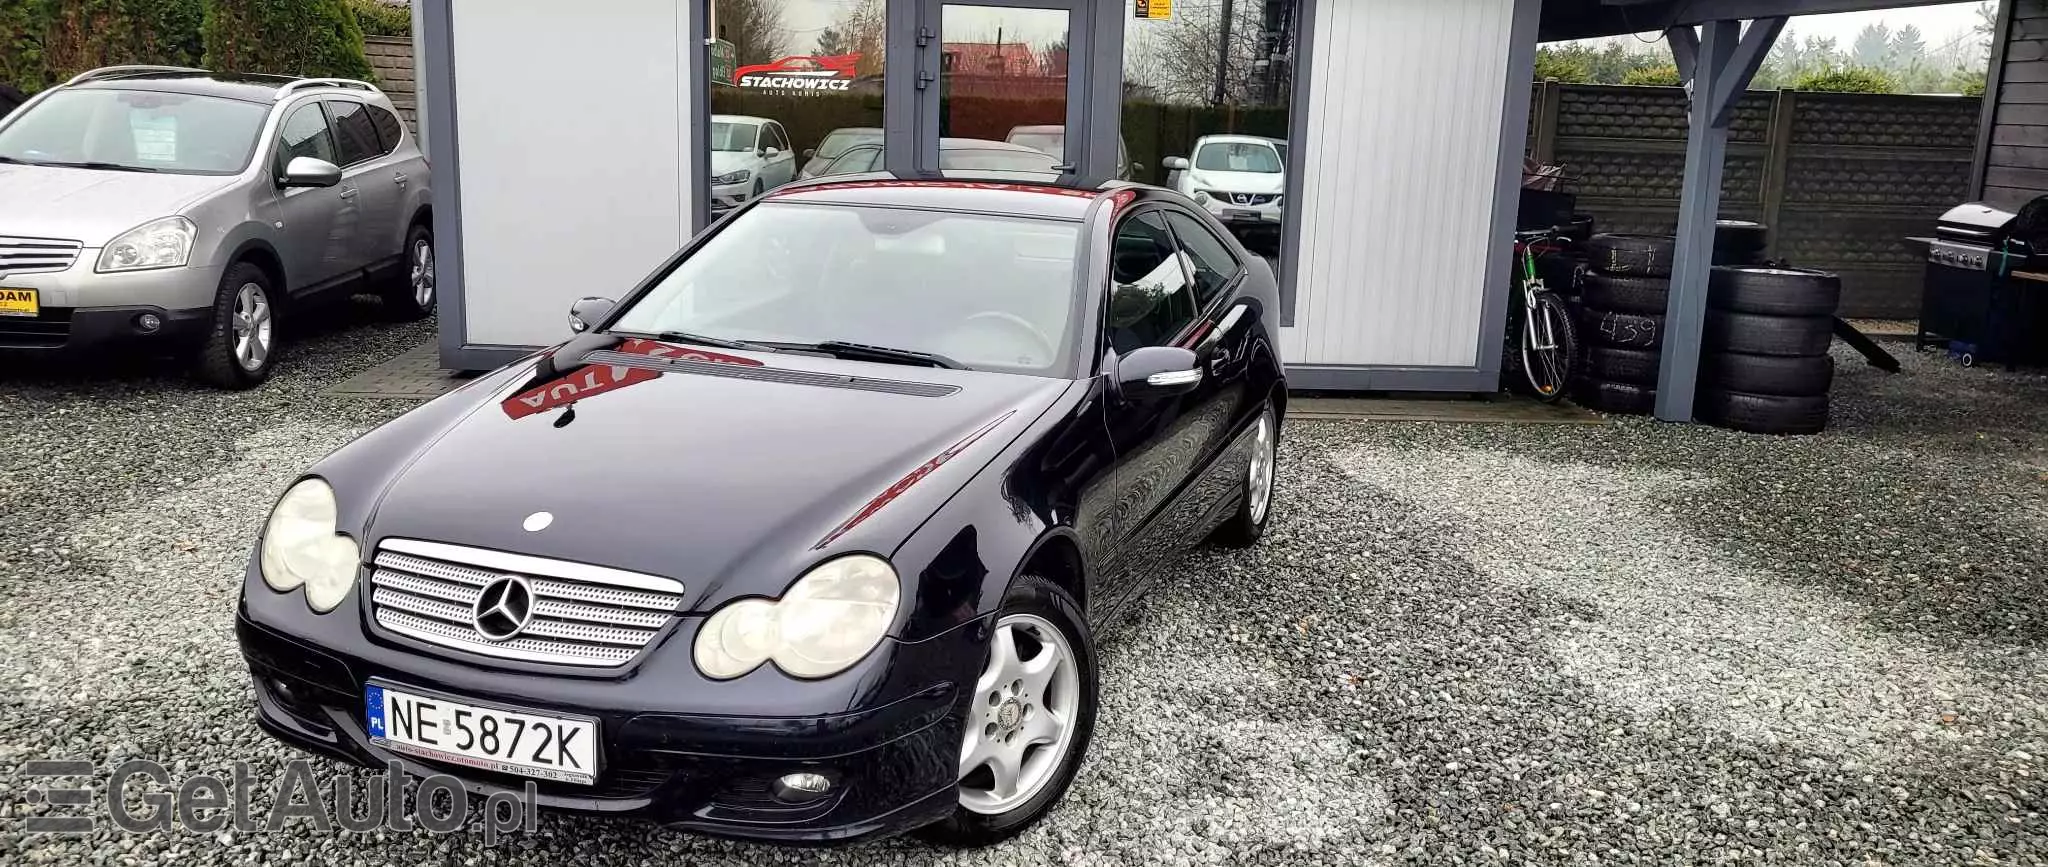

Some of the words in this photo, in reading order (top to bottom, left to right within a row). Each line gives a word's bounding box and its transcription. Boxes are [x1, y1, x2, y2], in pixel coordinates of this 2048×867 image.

[740, 76, 850, 91] STACHOWICZ
[370, 716, 384, 730] PL
[391, 696, 438, 745] NE
[454, 709, 582, 769] 5872K
